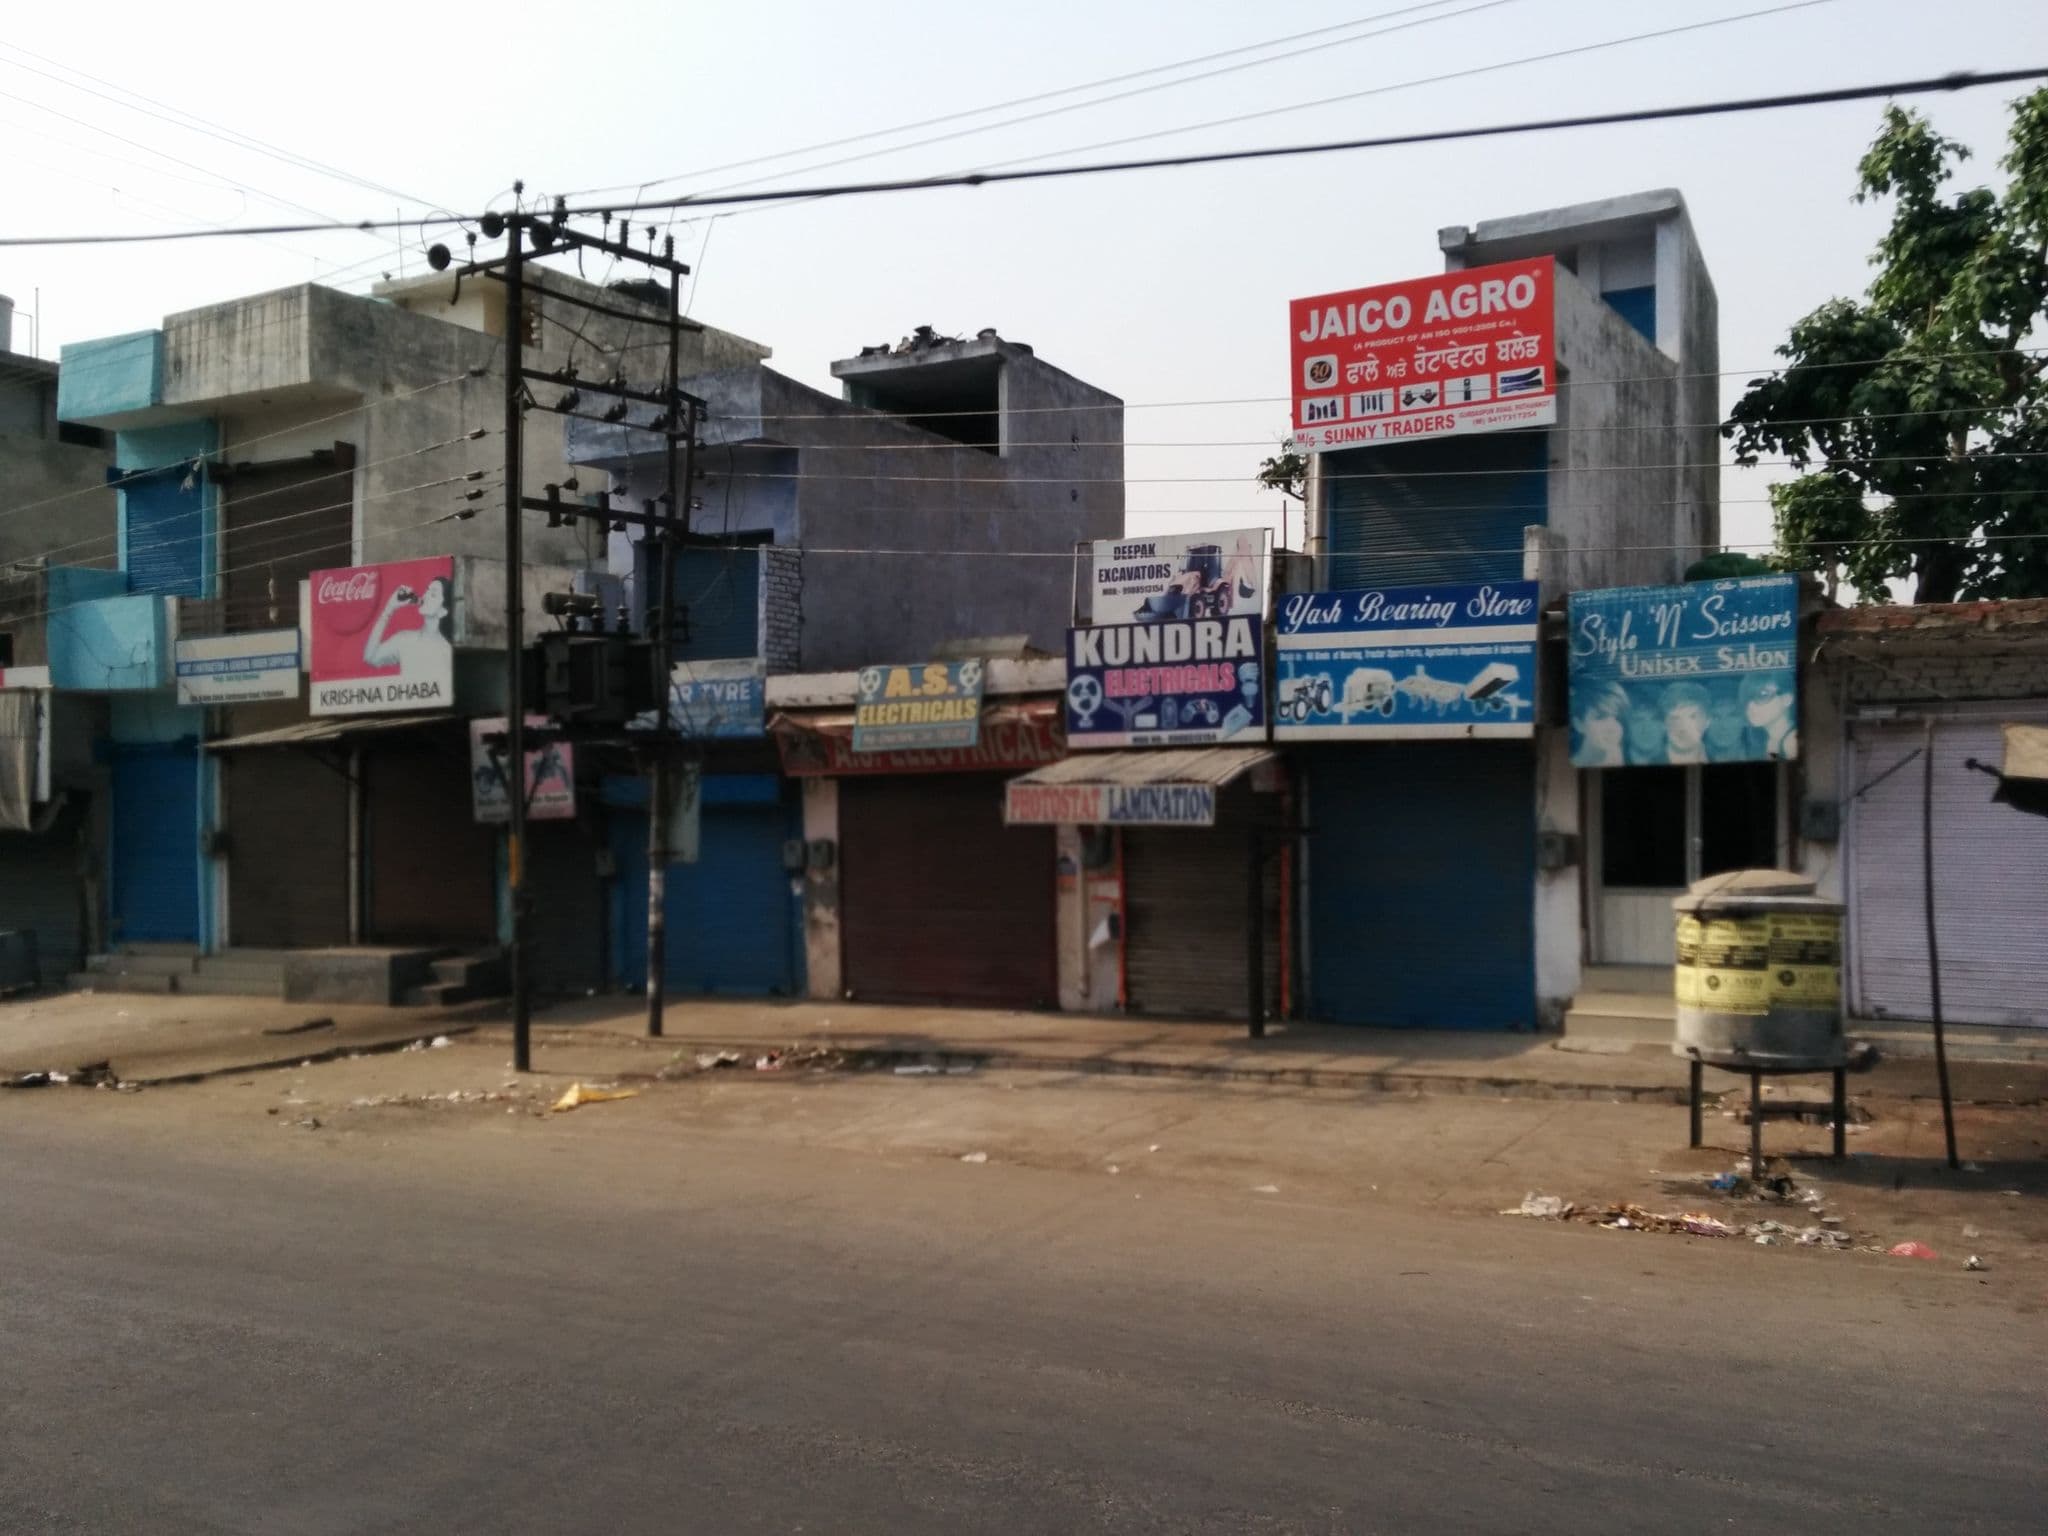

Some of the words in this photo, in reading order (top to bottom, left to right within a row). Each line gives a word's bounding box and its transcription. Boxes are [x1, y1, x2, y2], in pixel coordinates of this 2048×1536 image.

[1299, 295, 1412, 343] JAICO
[1423, 274, 1537, 325] AGRO
[1324, 424, 1377, 445] SUNNY
[1382, 414, 1456, 437] TRADERS
[1113, 543, 1156, 561] DEEPAK
[1098, 563, 1172, 583] EXCAVATORS
[1284, 594, 1343, 634] Yash
[1354, 591, 1457, 628] Bearing
[1467, 585, 1533, 618] Store
[1074, 618, 1256, 667] KUNDRA
[1572, 609, 1638, 664] Style
[1692, 594, 1792, 639] Scissors
[320, 685, 383, 707] KRISHNA
[387, 681, 441, 703] DHABA
[885, 662, 957, 698] A.S.
[1104, 662, 1236, 698] ELECTRICALS
[858, 699, 978, 726] ELECTRICALS
[1109, 786, 1212, 820] LAMINATION
